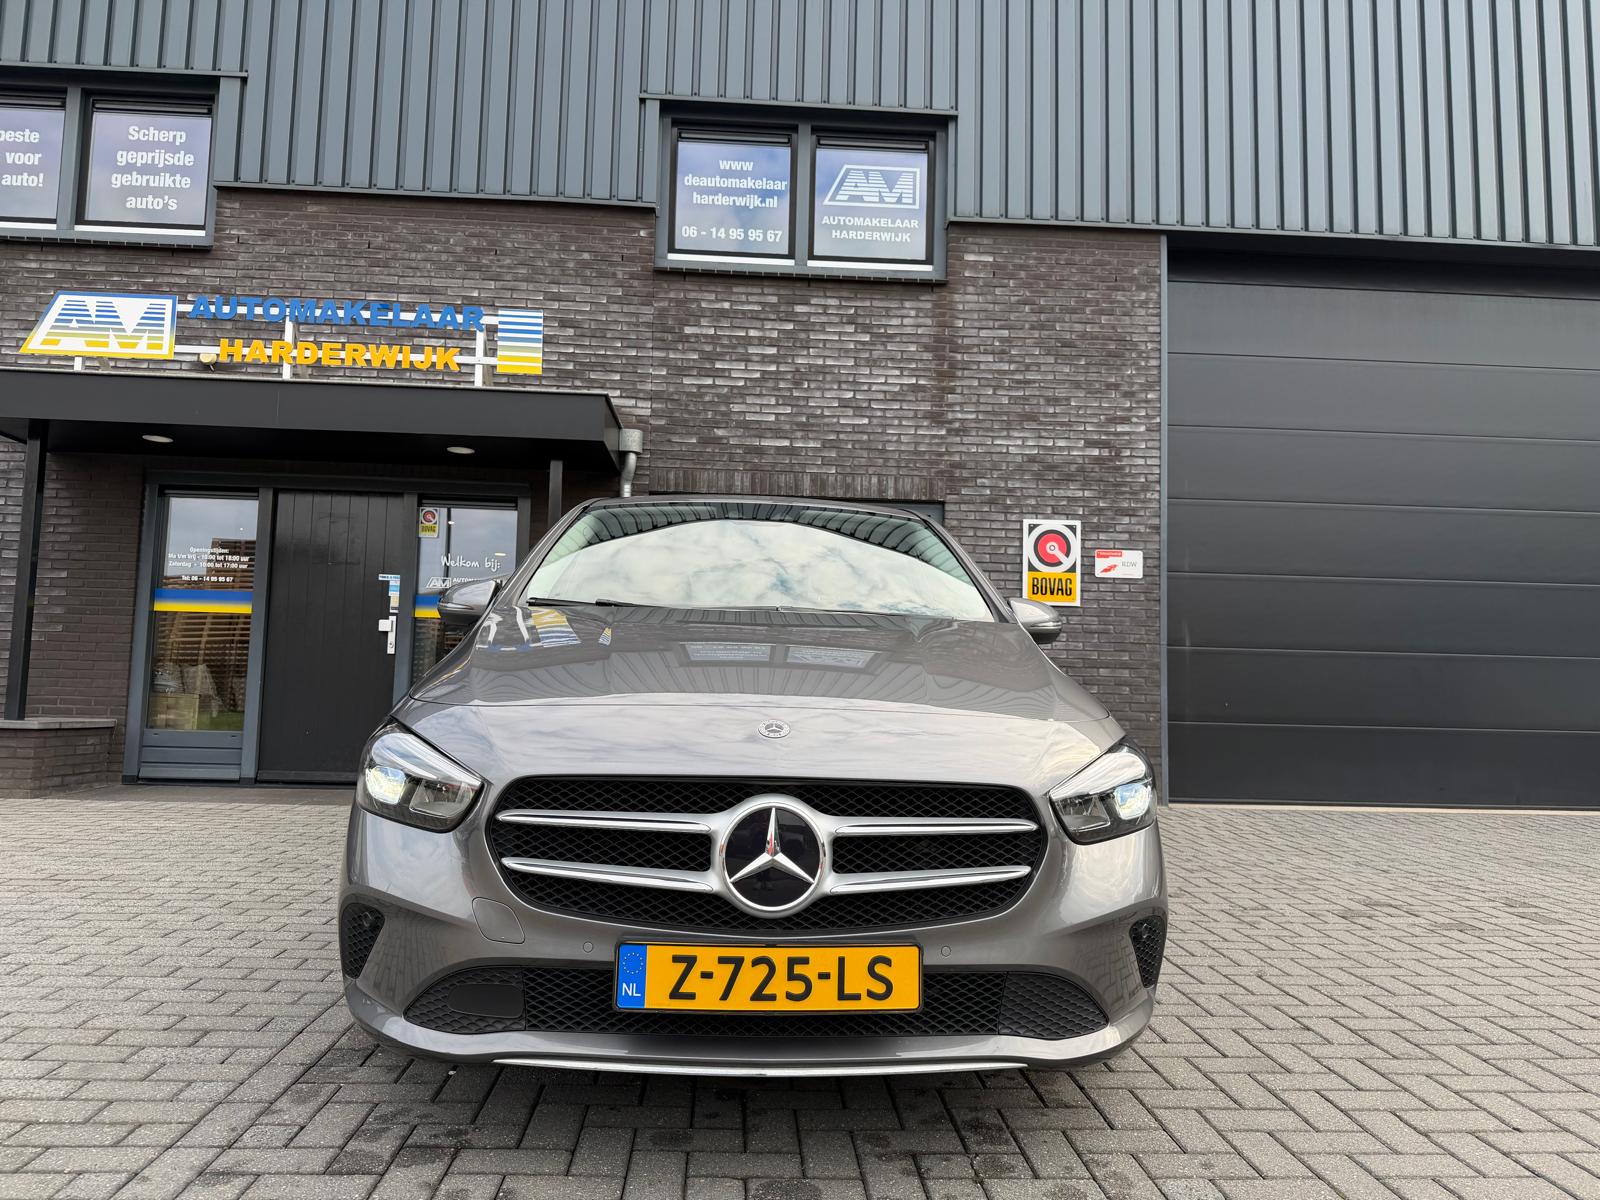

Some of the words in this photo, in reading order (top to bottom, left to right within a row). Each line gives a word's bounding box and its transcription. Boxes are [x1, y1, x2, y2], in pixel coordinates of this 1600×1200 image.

[128, 126, 186, 145] Scherp
[6, 152, 42, 165] voor
[116, 150, 194, 168] geprijsde
[719, 160, 754, 171] www
[1, 173, 43, 187] auto!
[111, 172, 191, 189] gebruikte
[684, 175, 787, 191] deautomakelaar
[835, 170, 913, 204] AM
[125, 196, 178, 210] auto's
[692, 192, 778, 208] harderwijk.nl
[822, 215, 919, 229] AUTOMAKELAAR
[682, 226, 698, 238] 06
[711, 227, 726, 240] 14
[729, 228, 745, 241] 95
[748, 229, 763, 241] 95
[767, 230, 782, 243] 67
[831, 230, 911, 242] HARDERWIJK
[187, 295, 485, 332] AUTOMAKELAAR
[39, 299, 167, 350] AM
[219, 338, 461, 372] HARDERWIJK
[441, 554, 480, 569] Welkom
[484, 557, 501, 573] bij:
[1031, 576, 1073, 597] BOVAG
[668, 954, 894, 1002] Z-725-LS
[621, 982, 641, 997] NL
